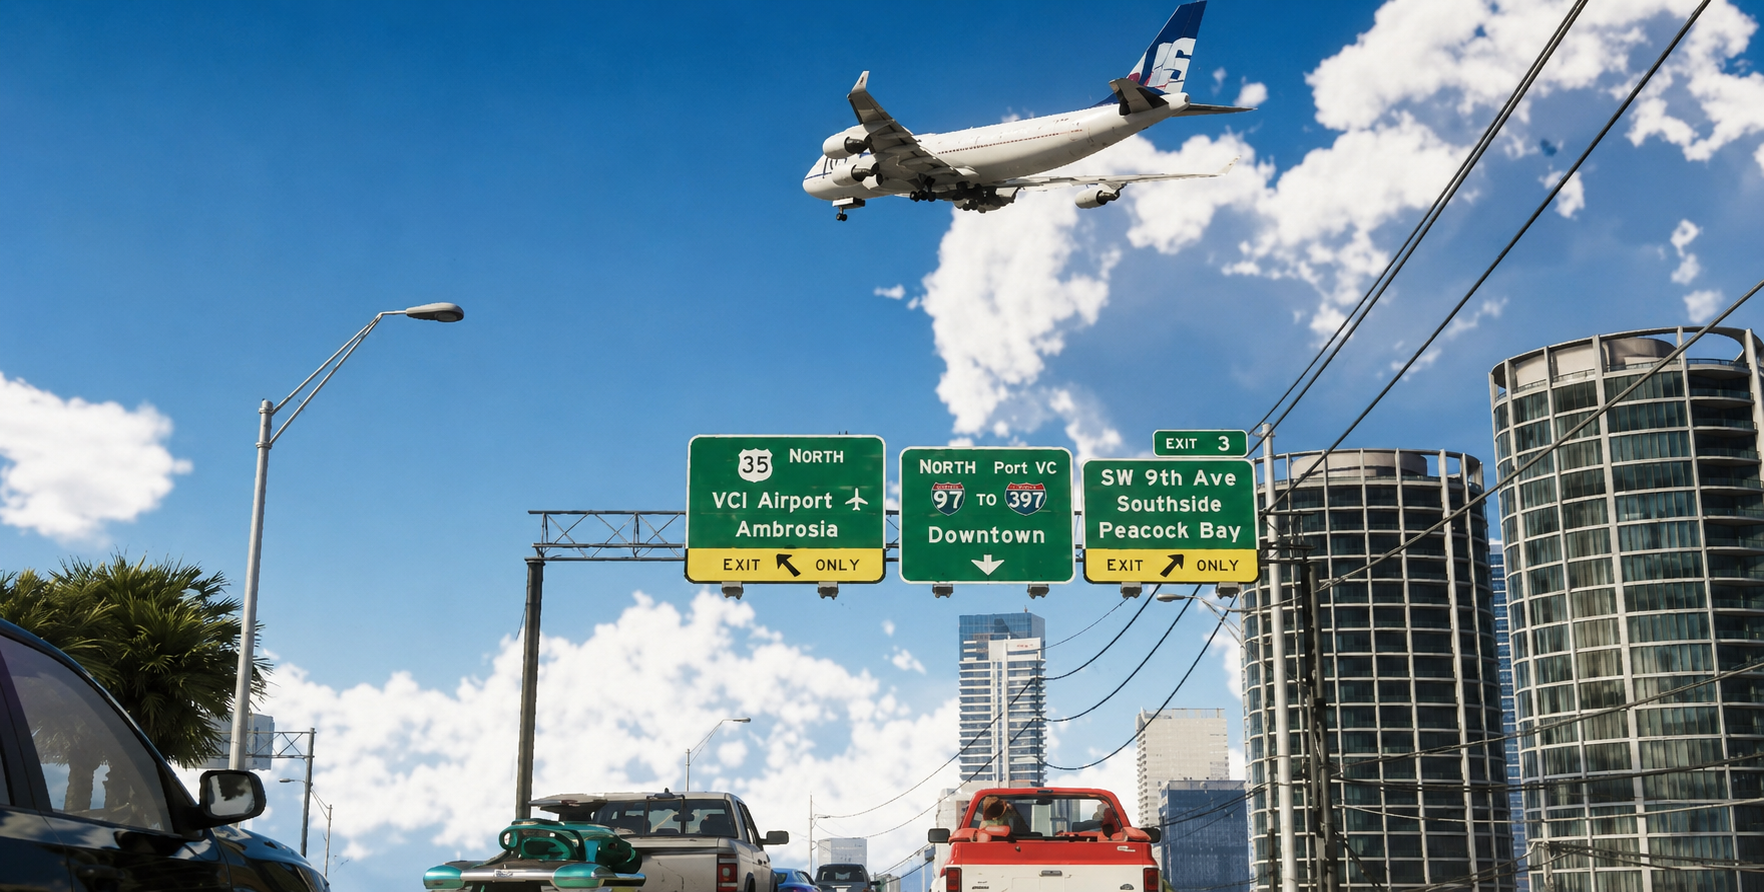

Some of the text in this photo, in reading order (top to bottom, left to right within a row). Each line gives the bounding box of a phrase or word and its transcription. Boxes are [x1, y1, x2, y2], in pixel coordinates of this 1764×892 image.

[1166, 436, 1230, 451] EXIT 3
[742, 448, 844, 473] 35 NORTH
[919, 459, 1057, 474] NORTH Port VC
[1101, 469, 1236, 486] SW 9th Ave
[712, 491, 833, 513] VCI Airport
[934, 491, 1043, 508] 97 TO 397
[1117, 495, 1222, 512] Southside
[735, 520, 838, 538] Ambrosia
[929, 526, 1045, 543] Downtown
[1099, 522, 1241, 543] Peacock Bay
[723, 559, 860, 571] EXIT ONLY
[1107, 559, 1239, 571] EXIT ONLY
